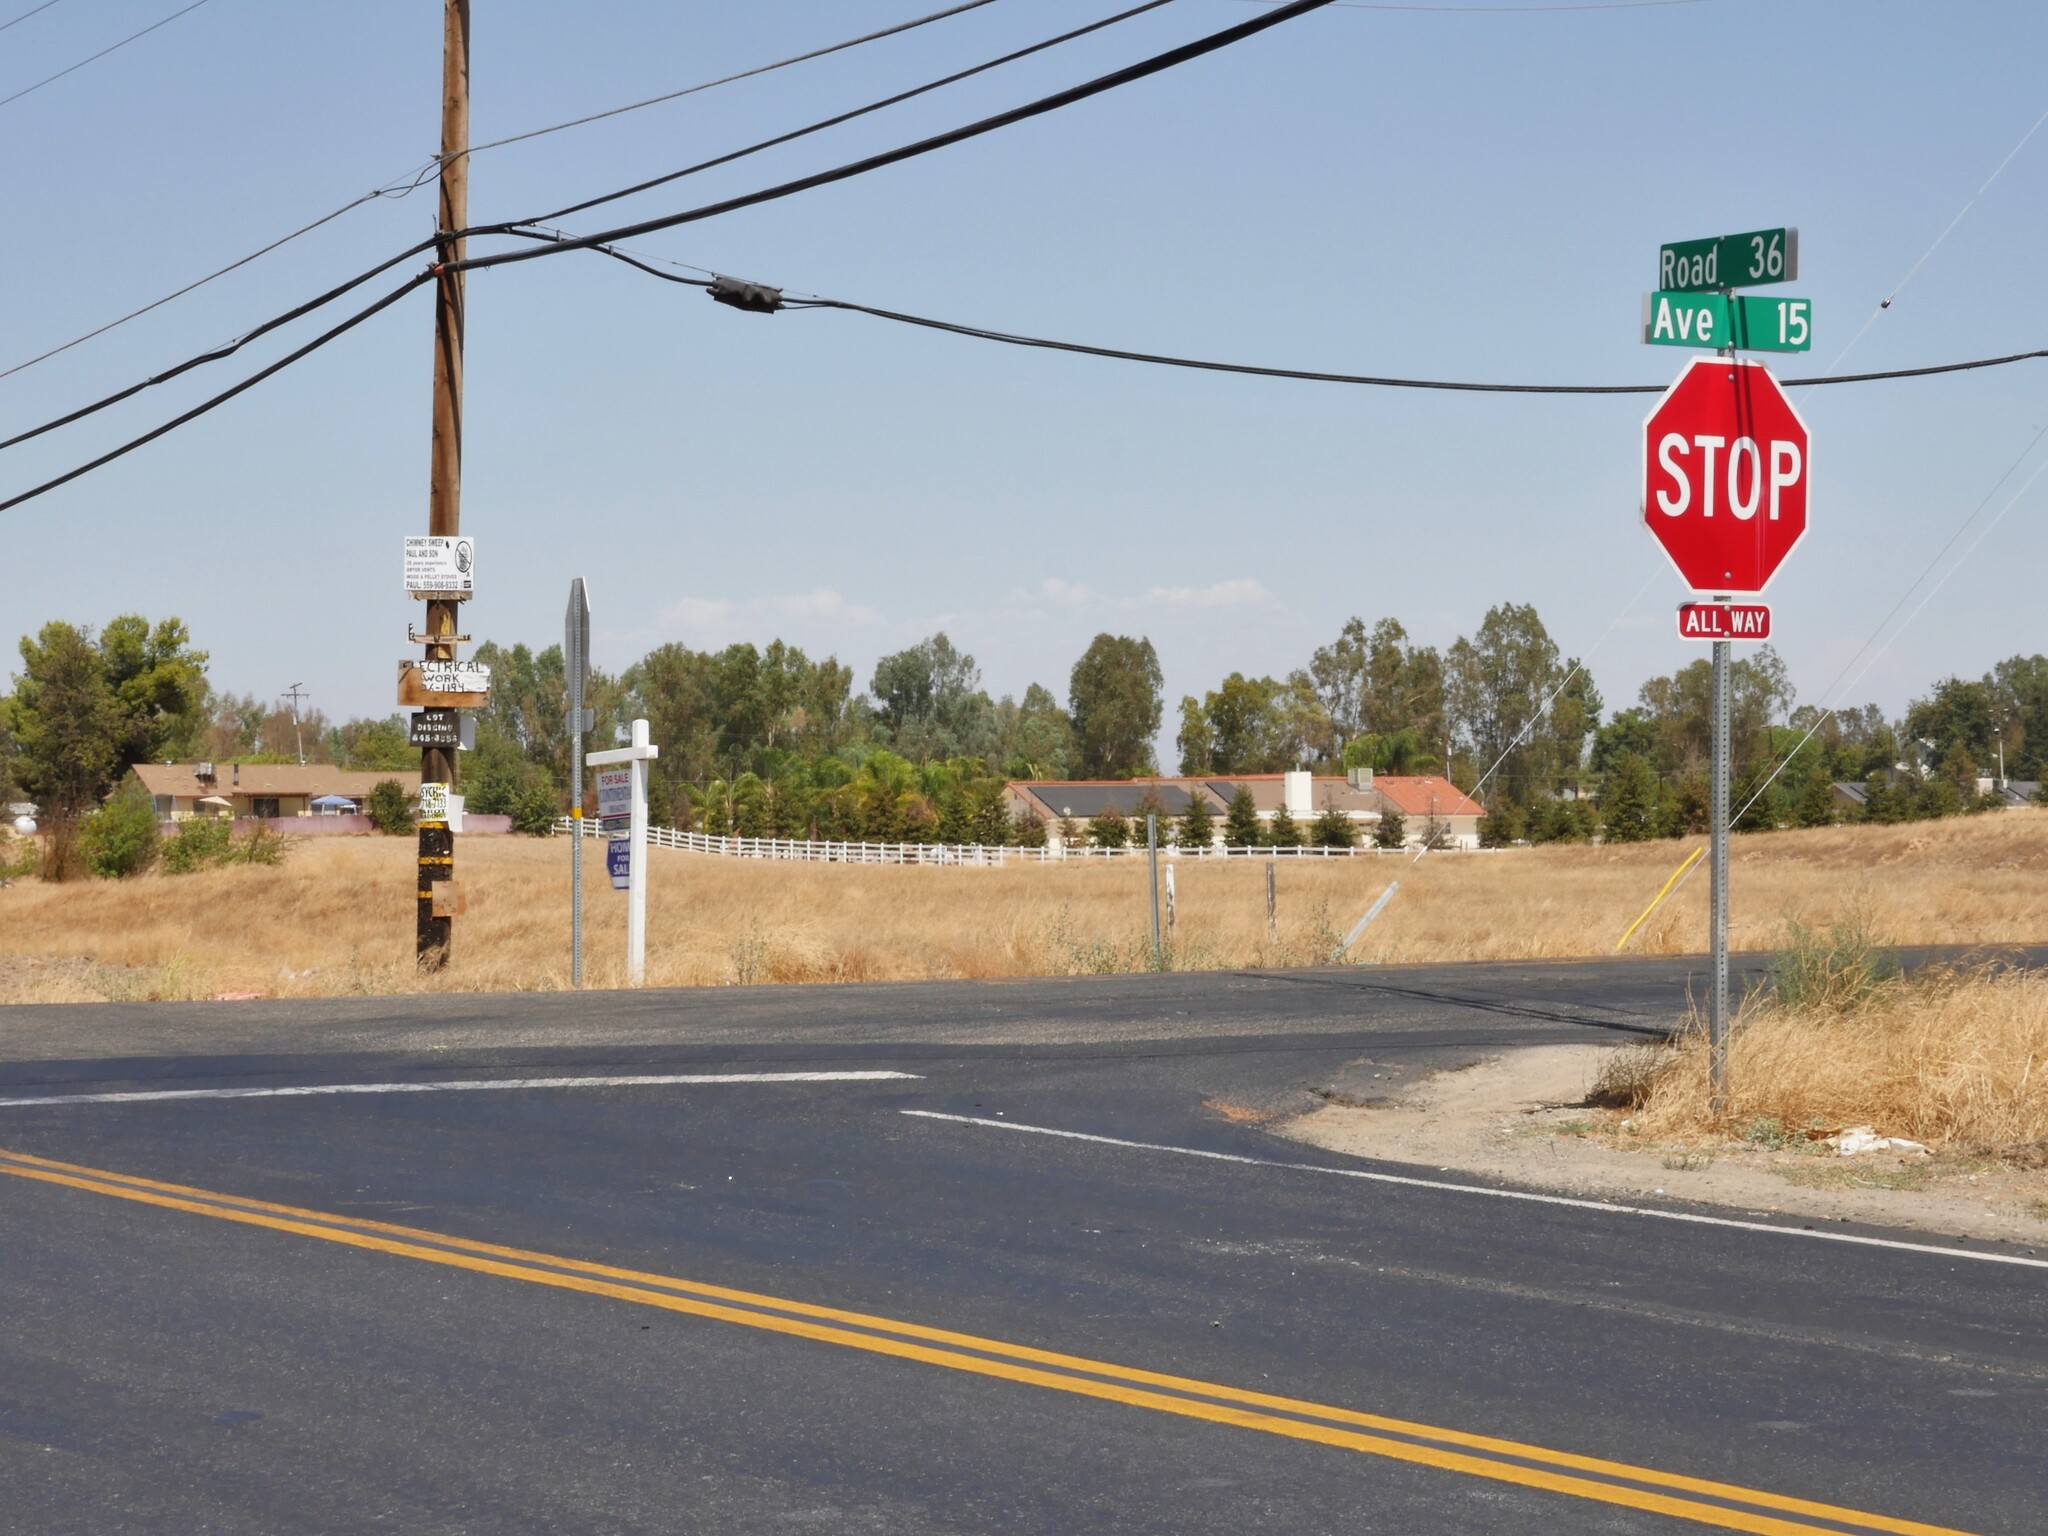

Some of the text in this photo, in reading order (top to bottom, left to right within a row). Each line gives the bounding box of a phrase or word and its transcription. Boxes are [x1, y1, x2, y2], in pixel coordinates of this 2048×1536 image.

[1661, 233, 1783, 290] Road 36
[1653, 297, 1809, 346] Ave 15
[1656, 432, 1802, 521] STOP
[406, 538, 444, 547] CHIMNEY SWEEP
[406, 549, 438, 558] PAUL AND SON
[1685, 610, 1765, 633] ALL WAY
[422, 674, 459, 684] WORK
[426, 713, 444, 721] LOT
[601, 773, 629, 785] FOR SALE
[421, 786, 446, 798] SYCHIC
[610, 841, 630, 853] HOM
[613, 863, 630, 875] SAL
